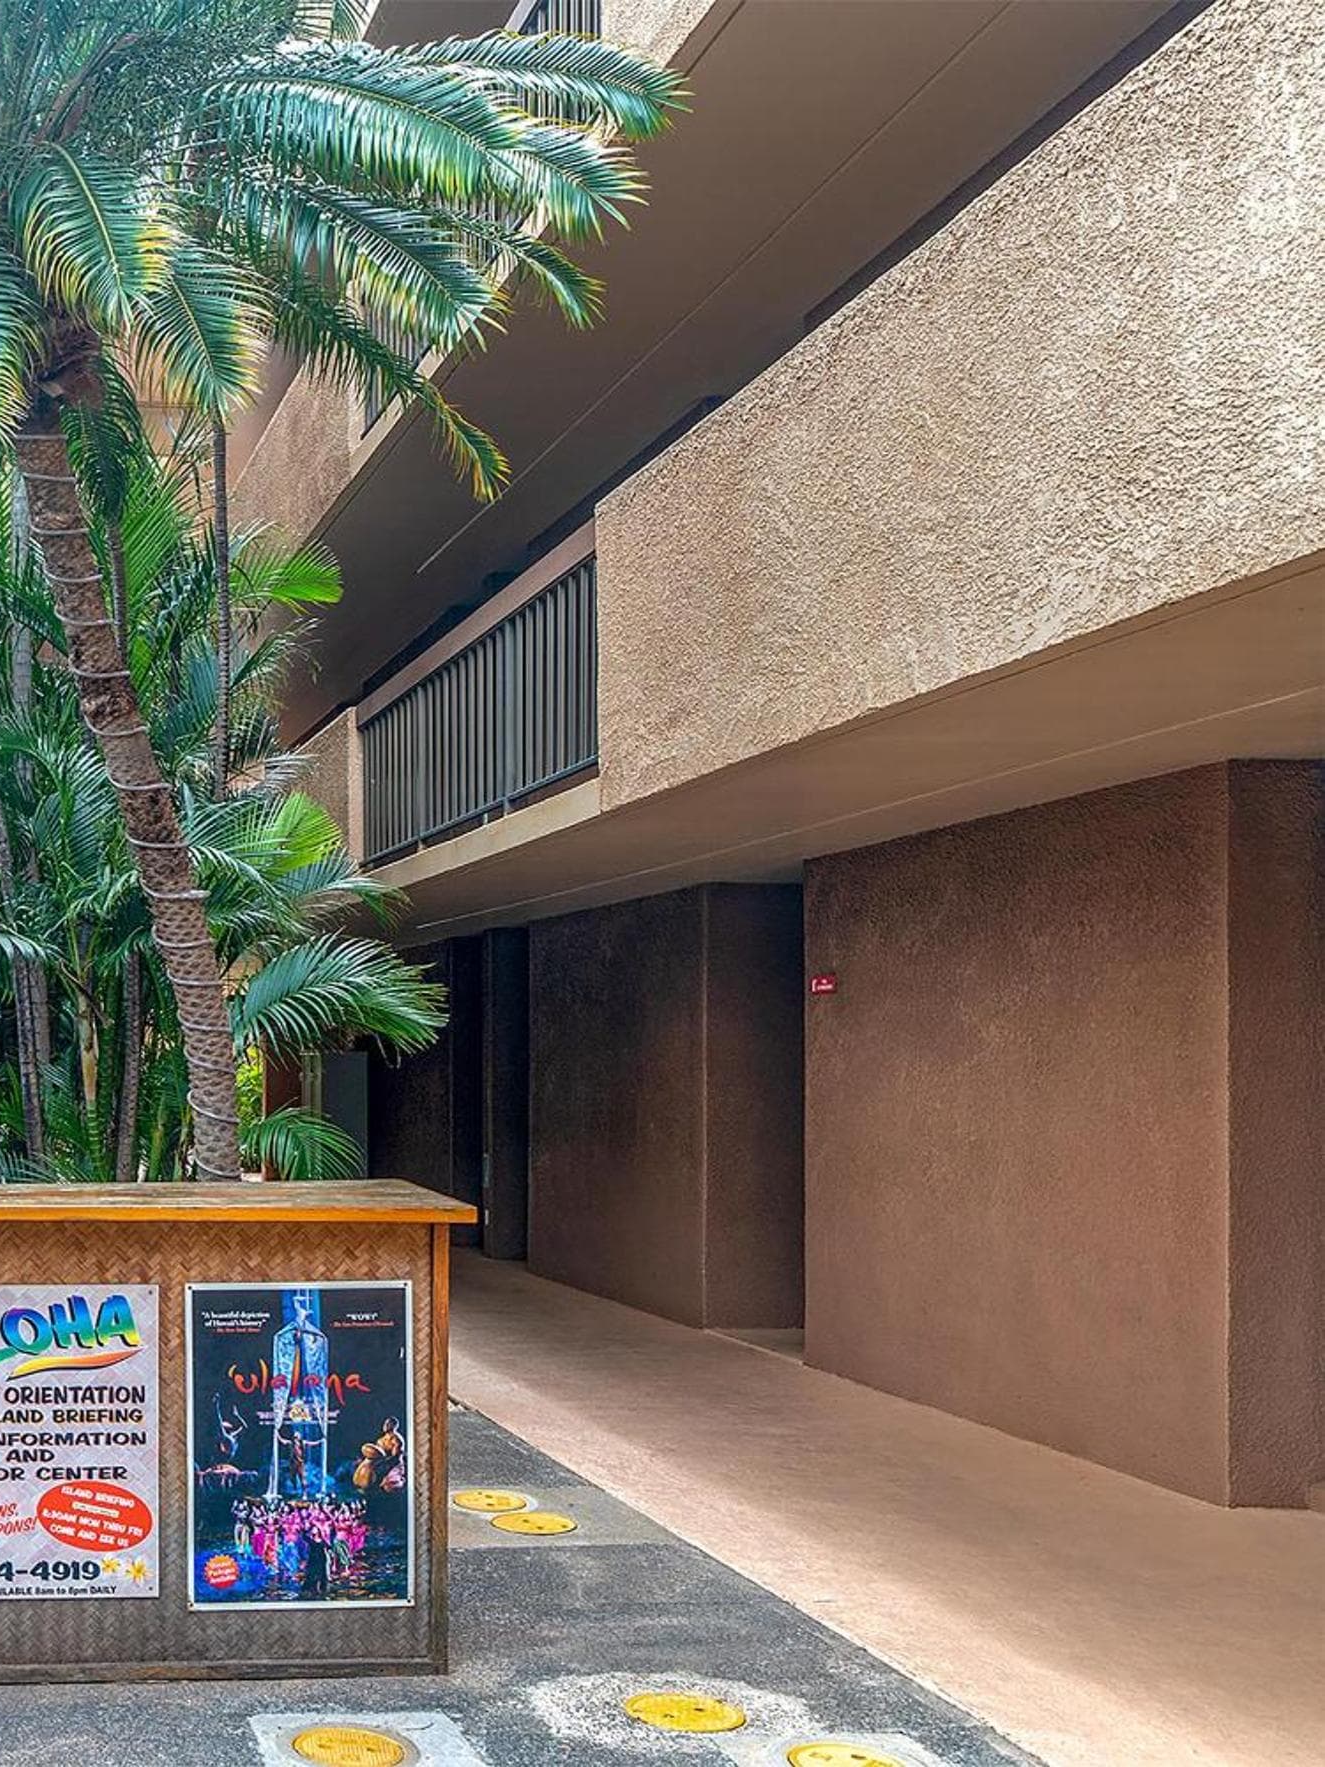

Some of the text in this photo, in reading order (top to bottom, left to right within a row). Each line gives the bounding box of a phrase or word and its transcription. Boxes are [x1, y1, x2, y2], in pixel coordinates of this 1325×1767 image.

[4, 1386, 146, 1404] ORIENTATION
[52, 1409, 144, 1424] BRIEFING
[5, 1449, 56, 1463] AND
[36, 1466, 128, 1481] CENTER
[60, 1486, 135, 1509] ISLAND BRIEFING
[78, 1515, 101, 1528] MON
[102, 1520, 127, 1533] THRU
[127, 1526, 144, 1538] FRI
[49, 1523, 130, 1547] COME AND SEE US
[55, 1587, 67, 1596] to
[90, 1586, 117, 1596] DAILY
